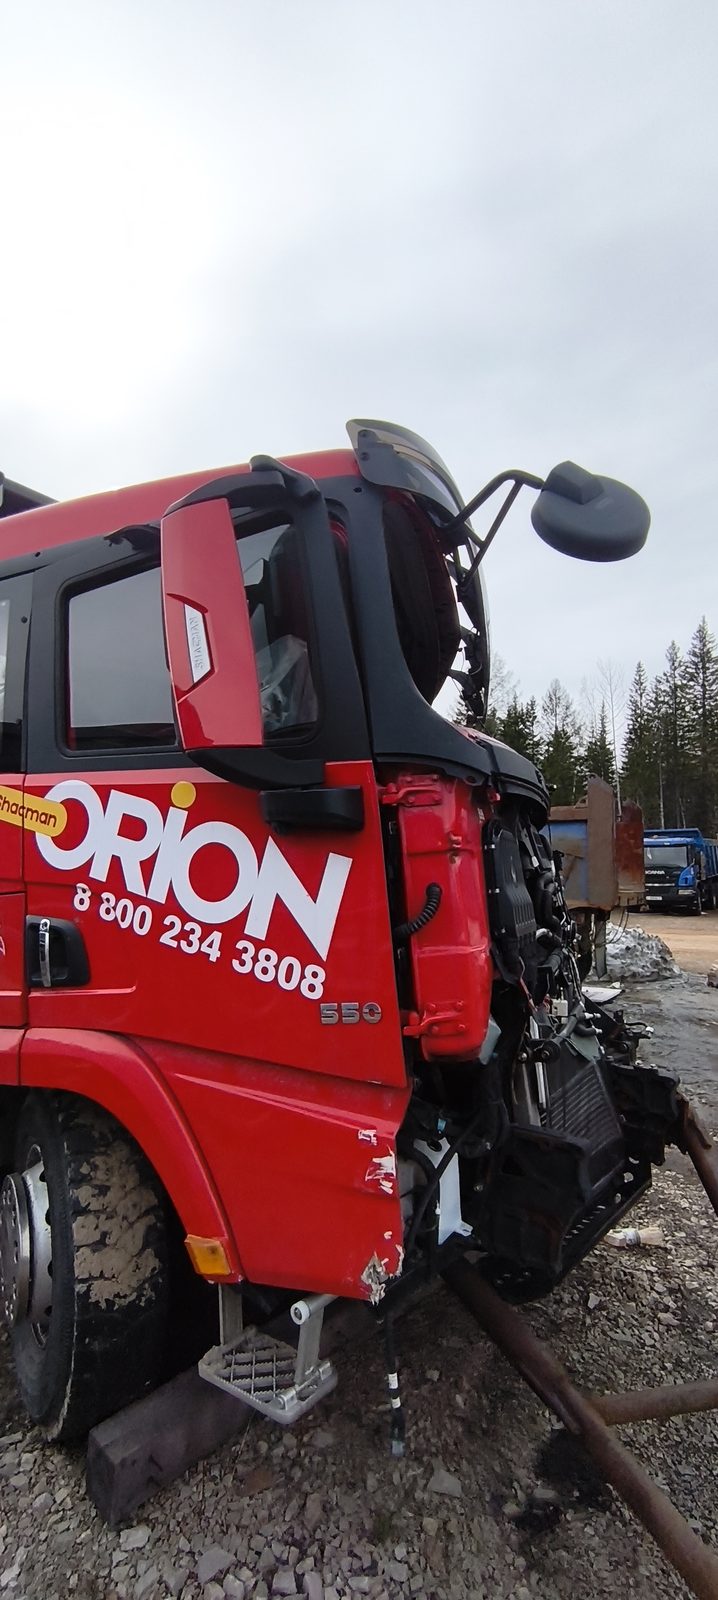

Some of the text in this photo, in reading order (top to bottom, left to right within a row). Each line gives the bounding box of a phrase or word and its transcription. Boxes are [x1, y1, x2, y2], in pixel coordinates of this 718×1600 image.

[73, 883, 326, 1000] 8 800 234 3808
[320, 1002, 381, 1024] 550
